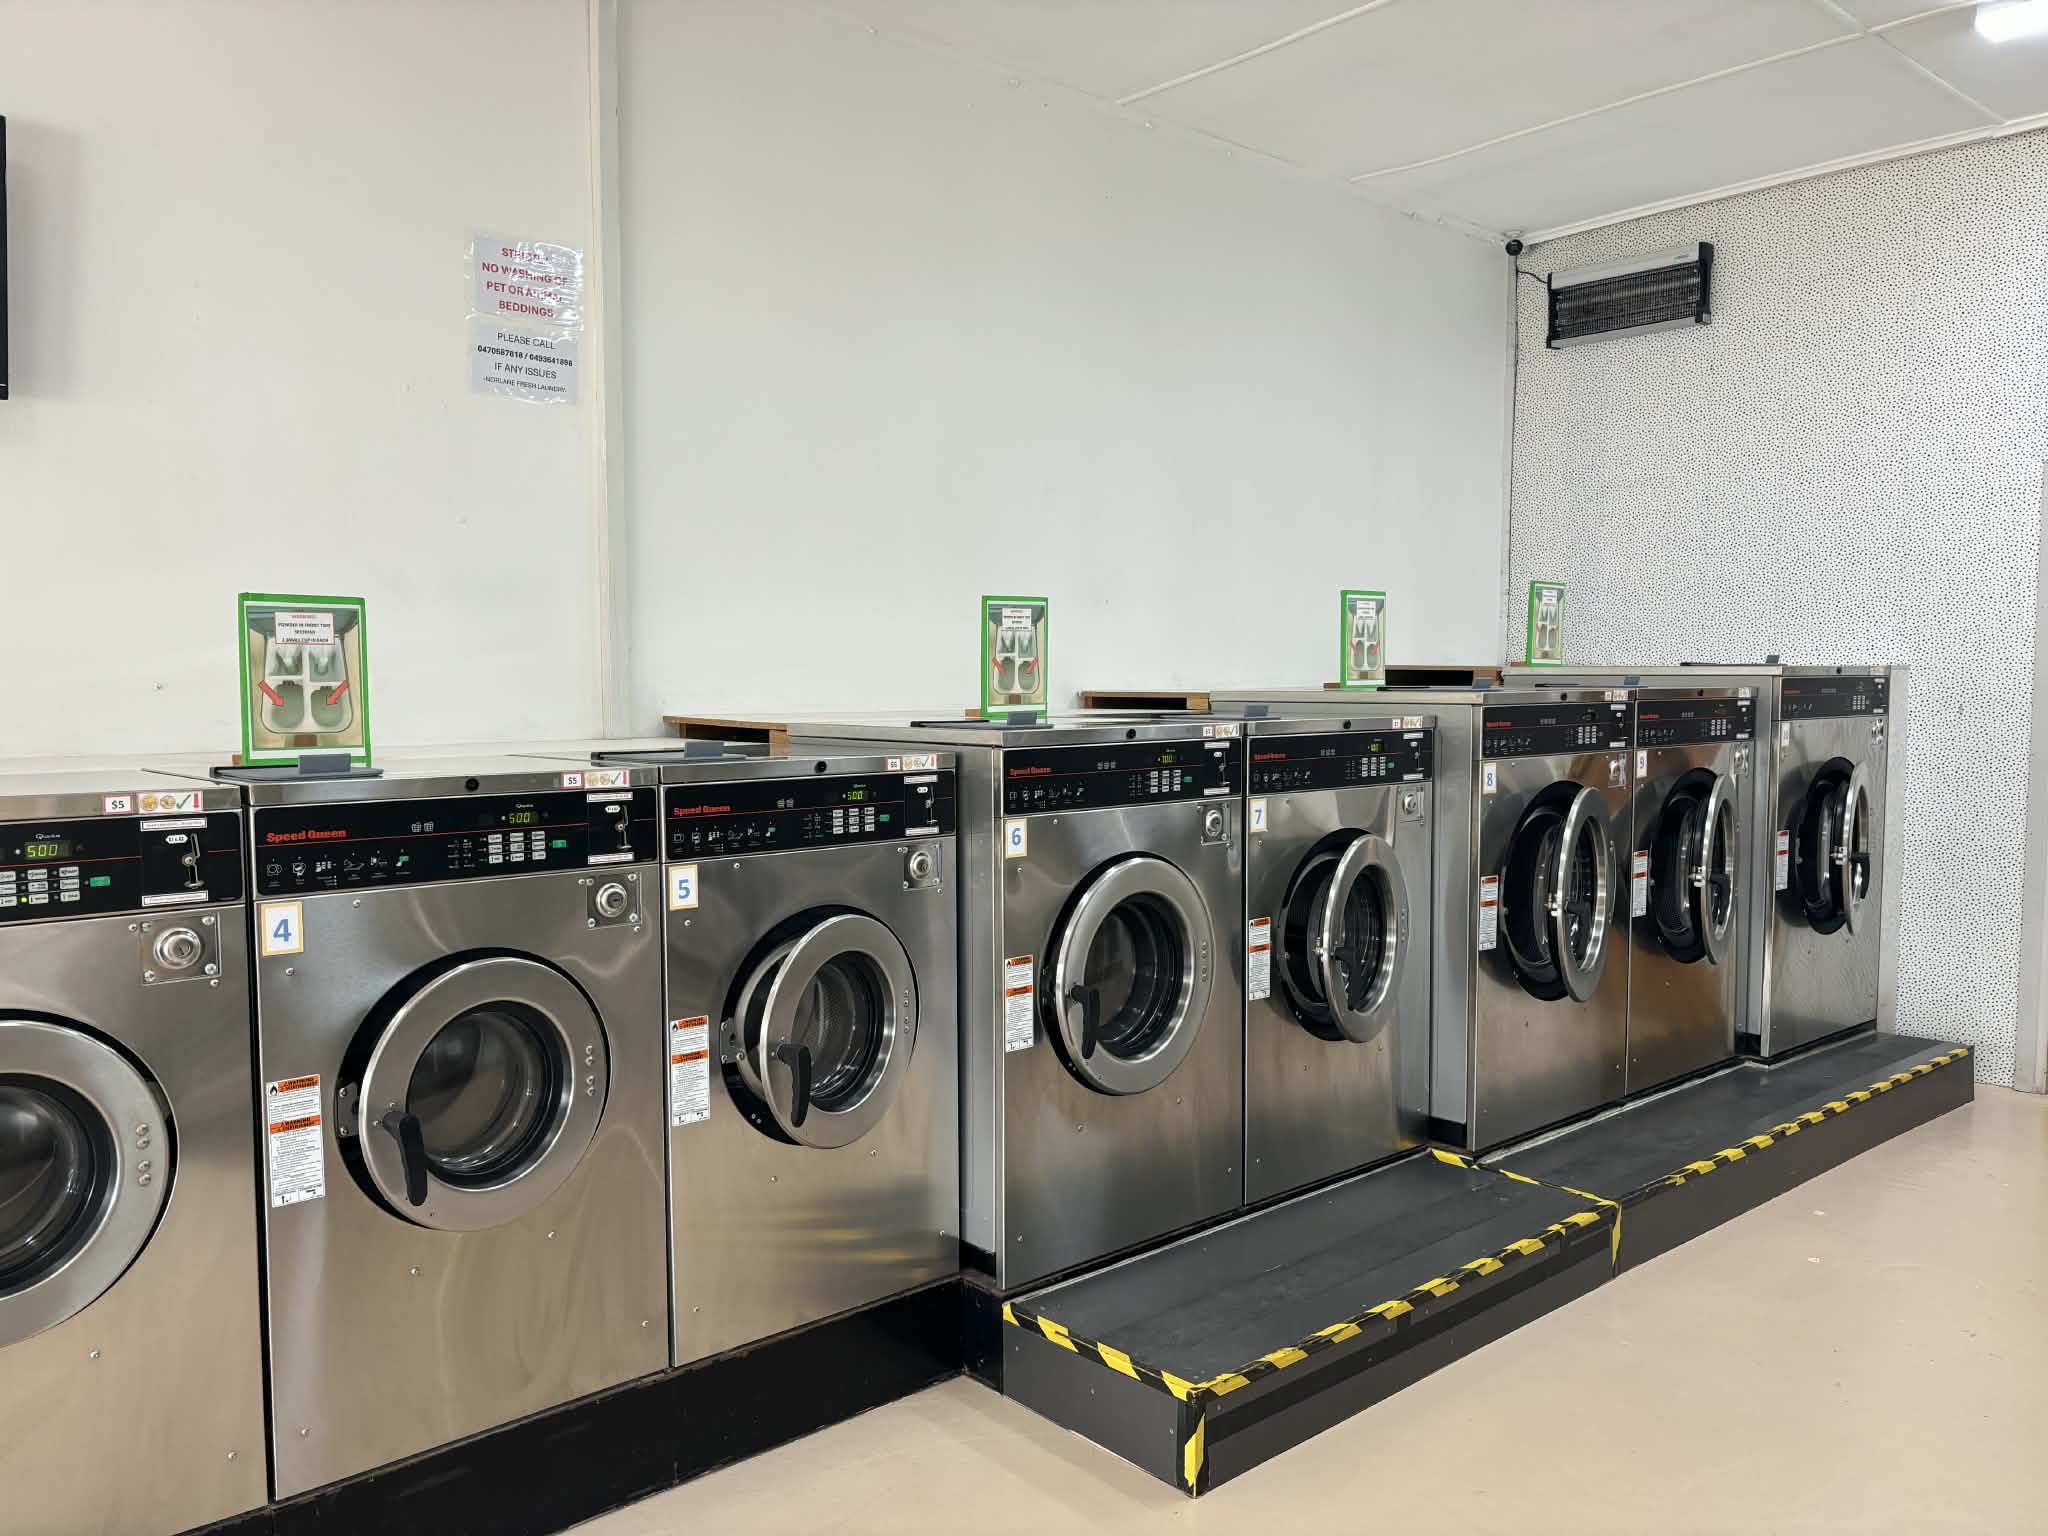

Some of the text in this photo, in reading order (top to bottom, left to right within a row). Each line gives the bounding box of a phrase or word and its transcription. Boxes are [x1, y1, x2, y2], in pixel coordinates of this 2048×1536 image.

[482, 262, 499, 273] NO
[501, 265, 552, 283] WASHING
[486, 281, 506, 292] PET
[508, 286, 524, 296] OR
[498, 300, 554, 317] BEDDINGS
[497, 332, 556, 350] PLEASE CALL
[494, 362, 557, 379] IF ANY ISSUES
[1487, 772, 1493, 786] 8
[111, 800, 125, 810] $5
[673, 806, 702, 816] Speed
[1254, 809, 1262, 825] 7
[266, 829, 347, 843] Speed Queen
[1011, 827, 1021, 846] 6
[27, 844, 58, 858] 500
[678, 879, 691, 899] 5
[273, 918, 292, 942] 4
